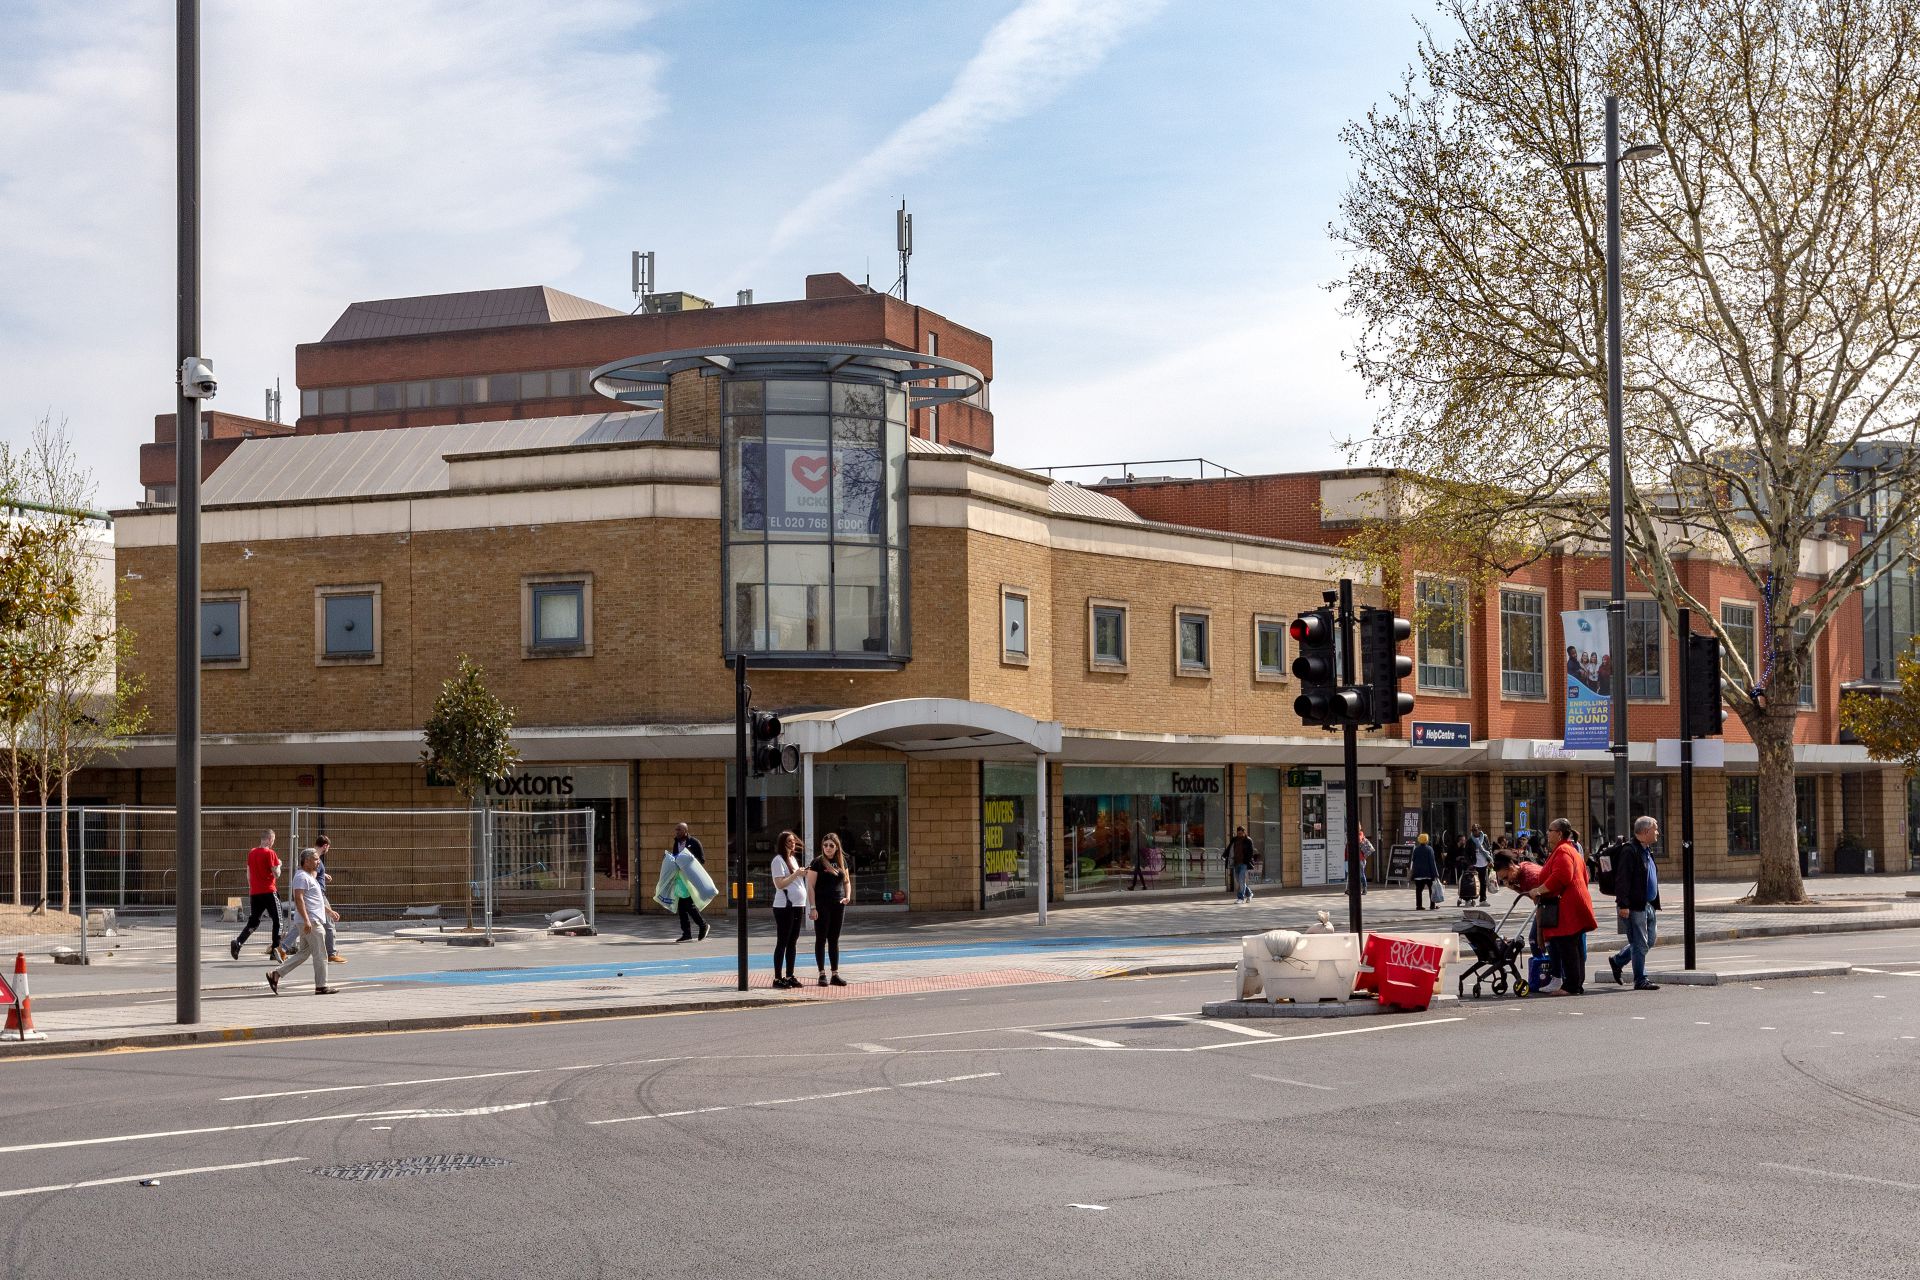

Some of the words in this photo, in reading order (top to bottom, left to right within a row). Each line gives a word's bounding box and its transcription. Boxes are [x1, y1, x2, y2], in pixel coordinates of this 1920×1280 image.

[785, 517, 804, 528] 020
[1568, 707, 1584, 715] ALL
[1587, 706, 1608, 714] YEAR
[1567, 715, 1608, 724] ROUND
[1425, 729, 1455, 741] HelpCentre
[1172, 771, 1219, 793] Foxtons
[985, 801, 1013, 824] MOVERS
[985, 826, 1003, 848] NEED
[985, 850, 1018, 873] SHAKERS
